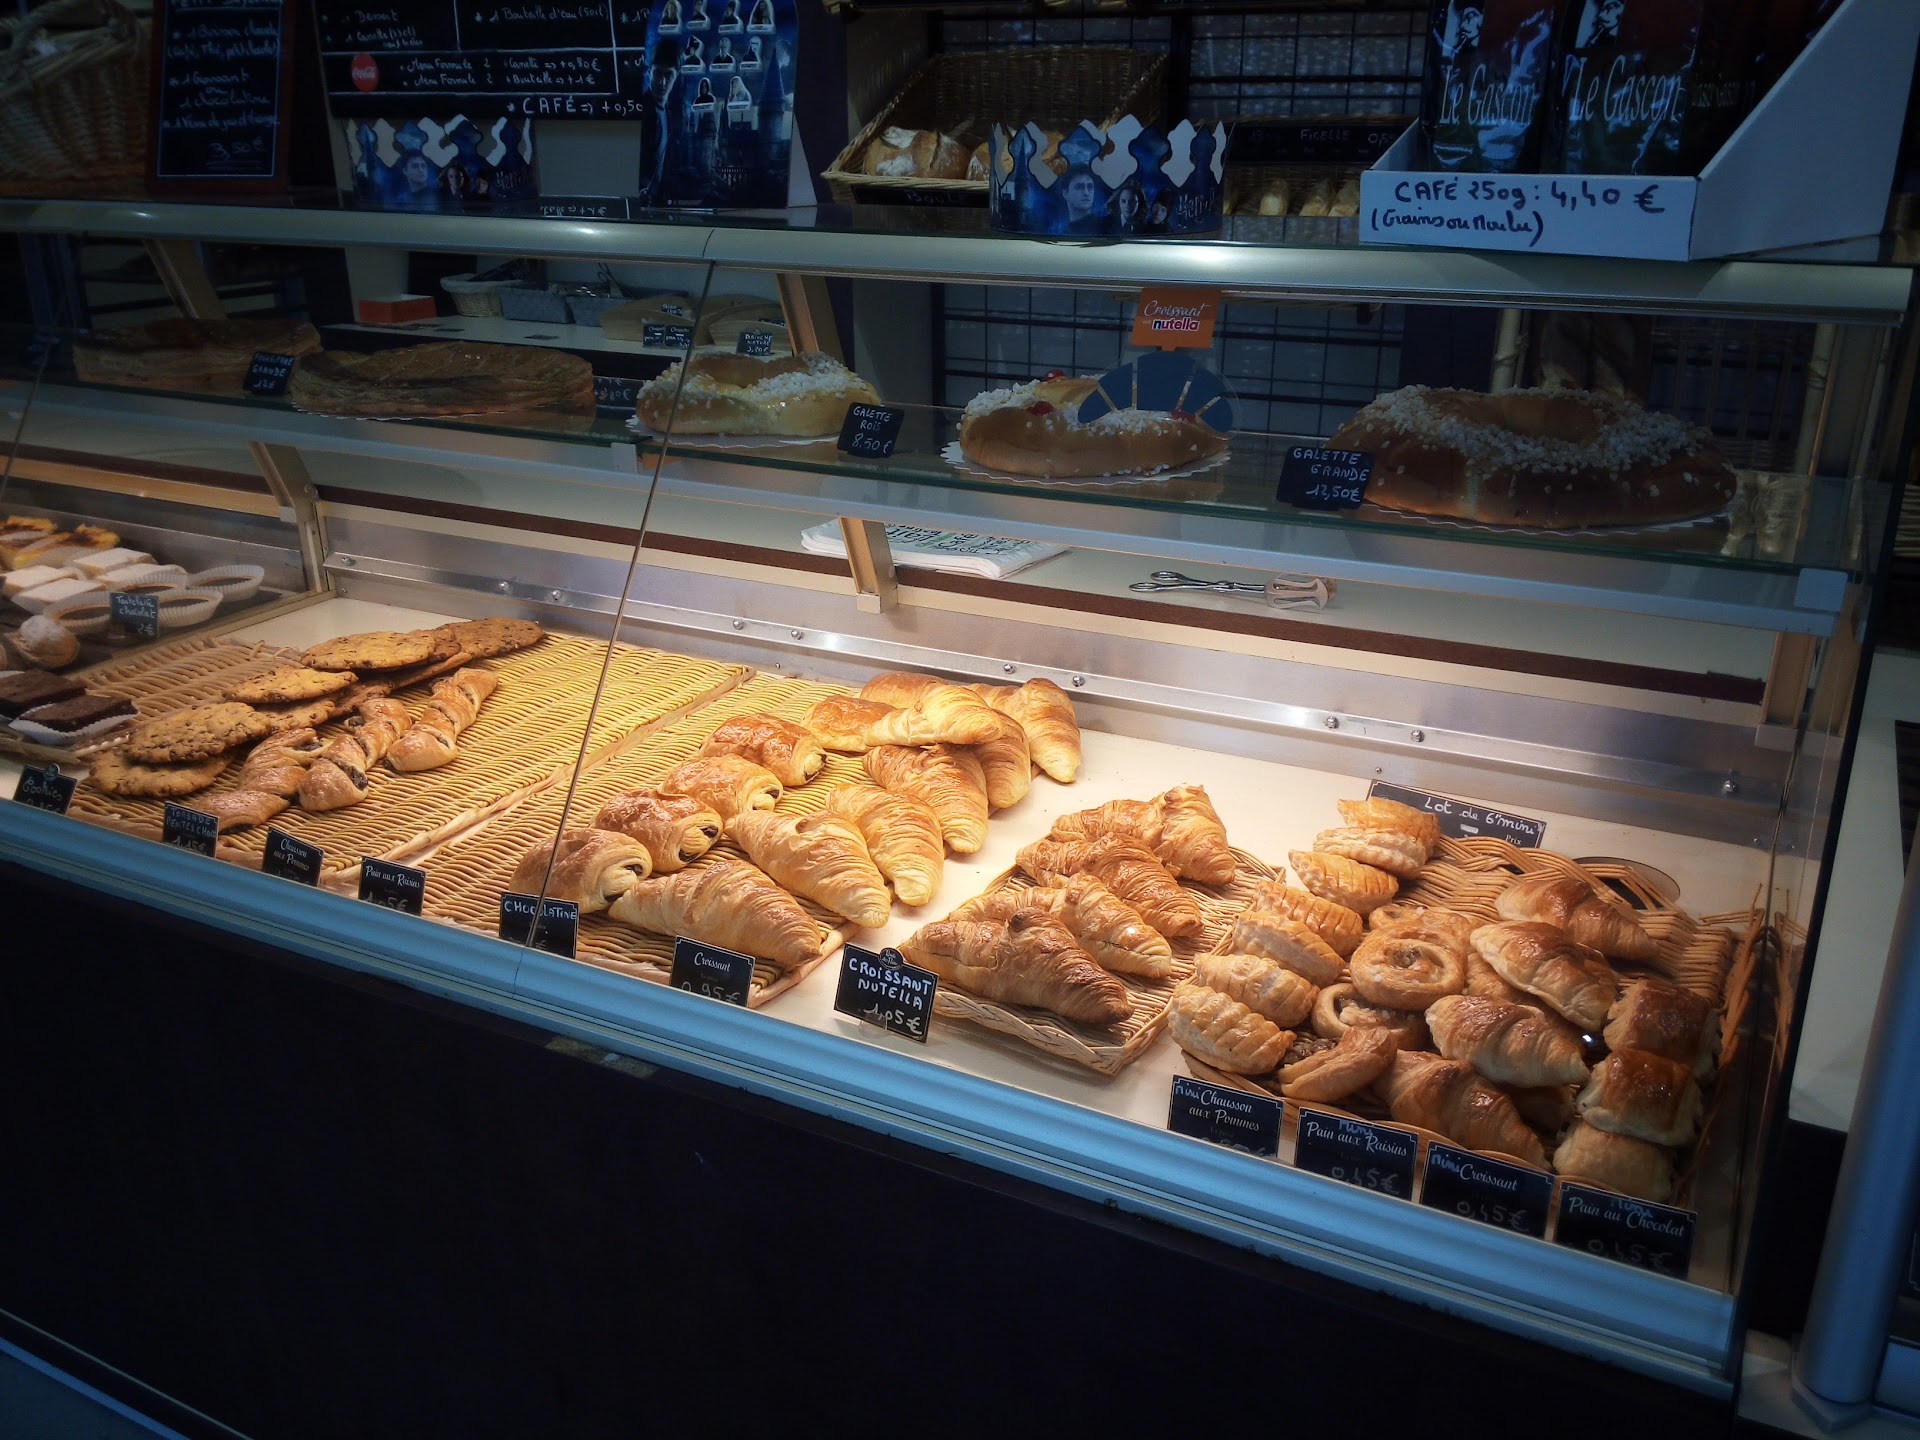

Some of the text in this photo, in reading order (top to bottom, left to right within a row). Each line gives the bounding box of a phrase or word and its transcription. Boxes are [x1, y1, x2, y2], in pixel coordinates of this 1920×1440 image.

[1440, 62, 1537, 126] Le Gascon
[1568, 56, 1600, 122] Le
[1602, 54, 1687, 122] Gascon
[522, 95, 577, 113] CAFÉ
[1395, 176, 1459, 203] CAFÉ
[1633, 183, 1666, 214] €
[1143, 299, 1212, 318] Croissant
[1152, 316, 1201, 332] nutella
[853, 405, 894, 423] GALETTE
[1292, 447, 1362, 466] GALETTE
[1310, 463, 1370, 482] GRANDE
[1424, 796, 1453, 814] Lot
[1458, 806, 1480, 820] de
[1504, 833, 1523, 845] Prix
[365, 864, 421, 889] Pain aux Raisins
[694, 951, 731, 972] Croissant
[849, 957, 932, 995] CROISSANT
[1200, 1089, 1253, 1114] Chausson
[1189, 1106, 1261, 1132] aux Pommes
[1306, 1120, 1408, 1157] Pain aux Raisins
[1459, 1163, 1519, 1192] Croissant
[1568, 1196, 1686, 1238] Pain au Chocolat
